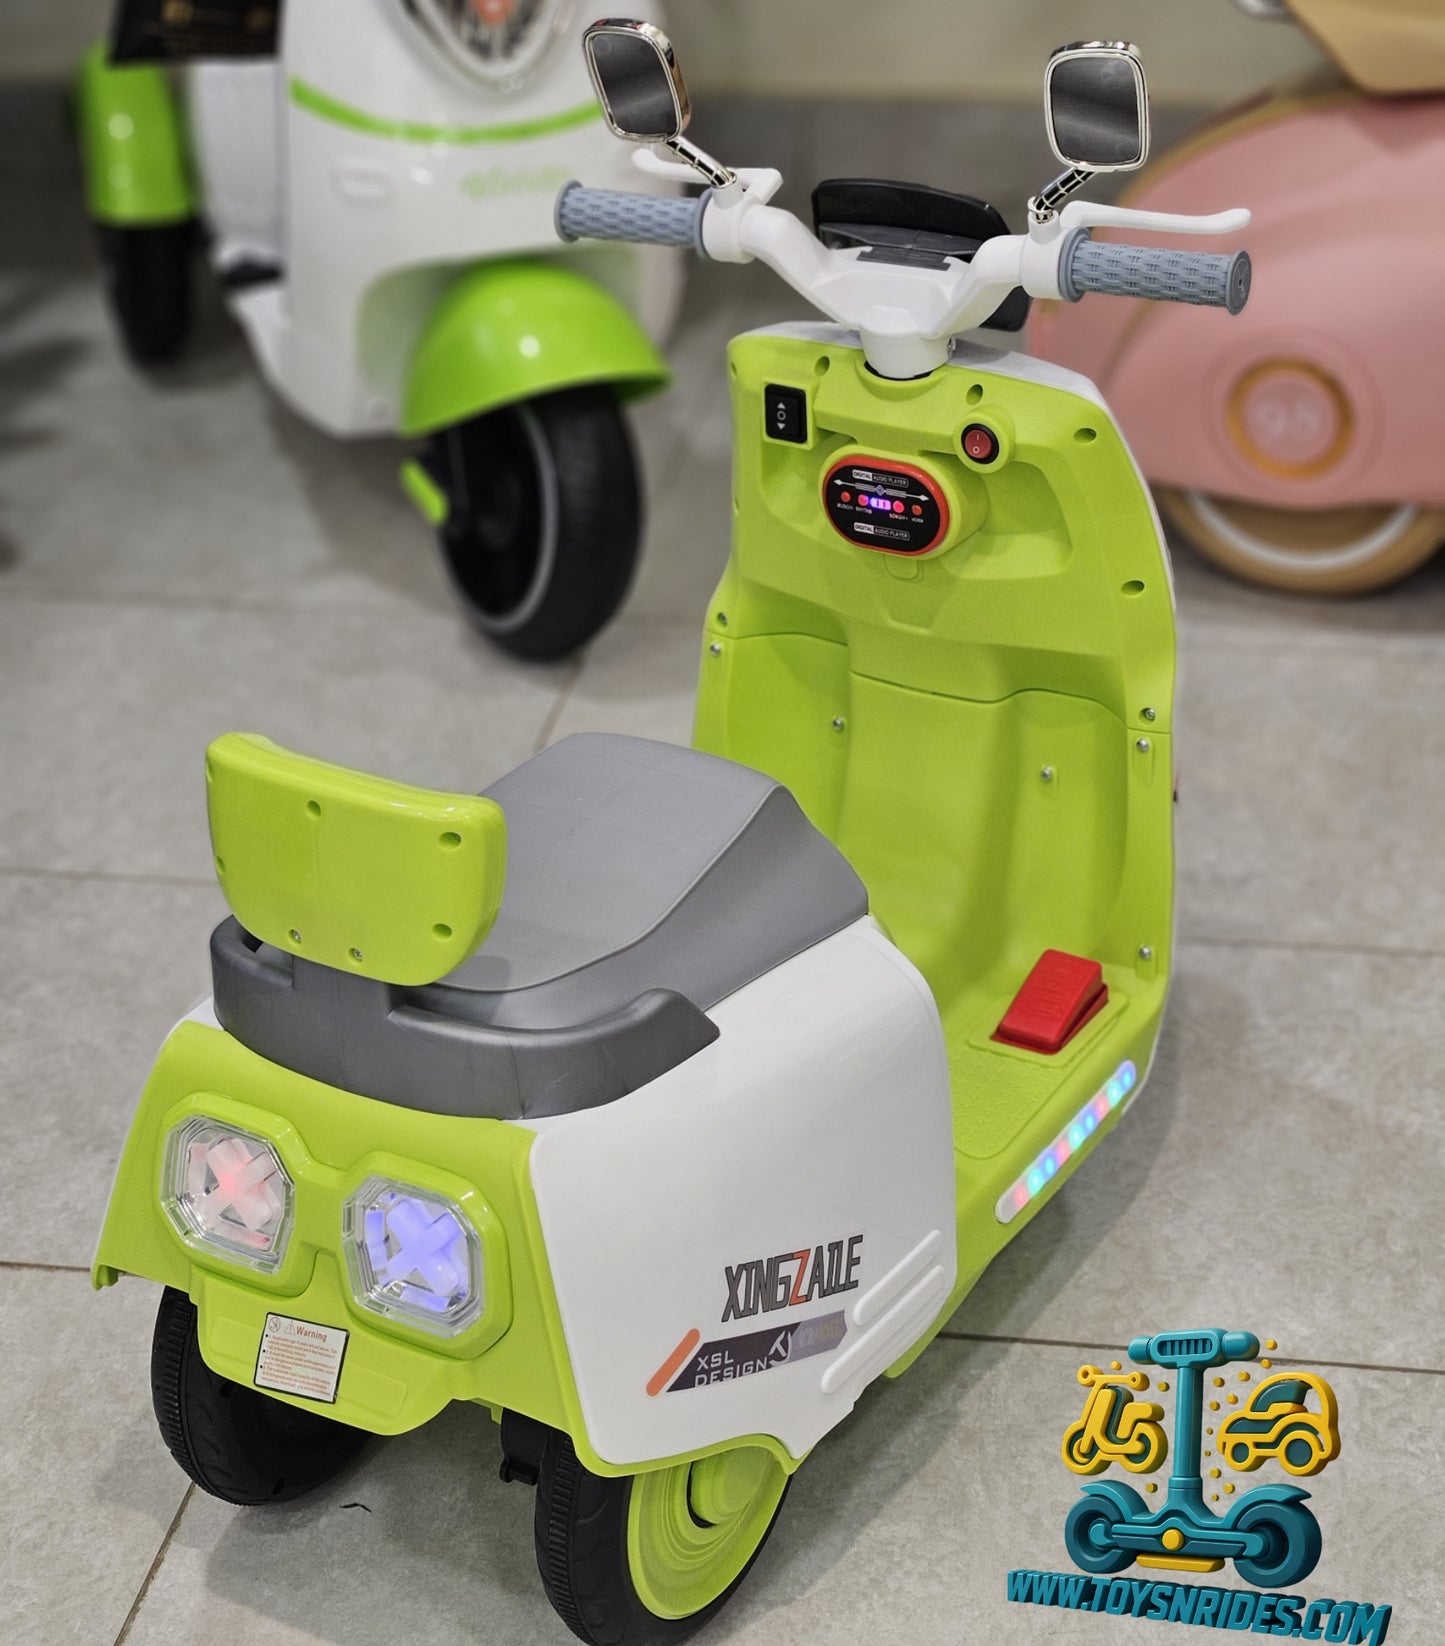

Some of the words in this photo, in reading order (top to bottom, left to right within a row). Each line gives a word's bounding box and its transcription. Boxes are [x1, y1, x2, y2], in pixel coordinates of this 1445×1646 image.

[853, 471, 872, 480] DIGITAL
[888, 477, 907, 485] PLAYER
[855, 524, 874, 533] DIGITAL
[721, 1234, 863, 1322] XINGZAILE
[296, 1325, 328, 1343] Warning
[696, 1350, 734, 1372] XSL
[694, 1356, 769, 1388] DESIGN
